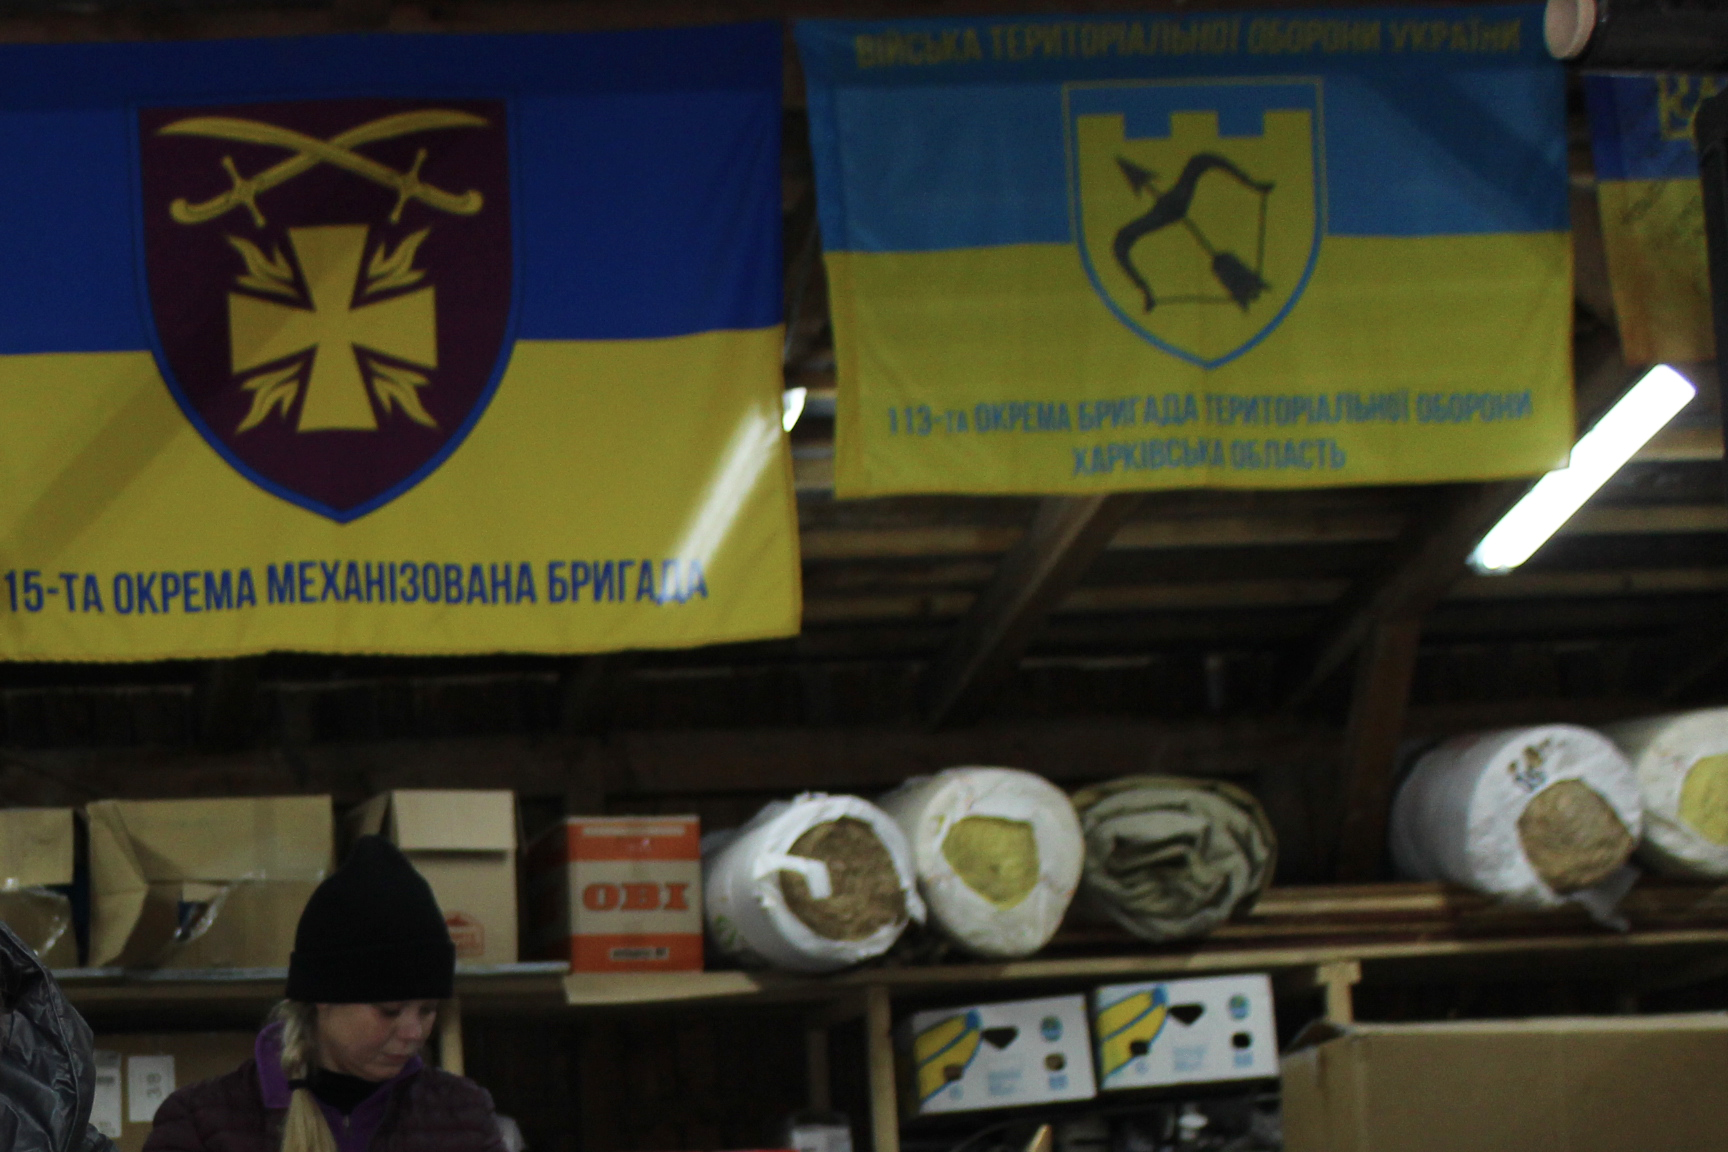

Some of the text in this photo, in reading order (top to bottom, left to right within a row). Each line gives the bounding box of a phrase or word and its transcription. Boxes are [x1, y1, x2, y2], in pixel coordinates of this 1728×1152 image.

[974, 399, 1070, 432] ОКРЕМА
[1076, 394, 1199, 431] БРИГАДА
[1417, 390, 1533, 424] ОБОРОНИ
[1073, 437, 1346, 477] ХАРКІВСЬКА ОБЛАСТЬ
[112, 567, 258, 614] ОКРЕМА
[266, 559, 538, 605] МЕХАНІЗОВАНА
[546, 559, 709, 606] БРИГАДА
[583, 882, 689, 912] OBI
